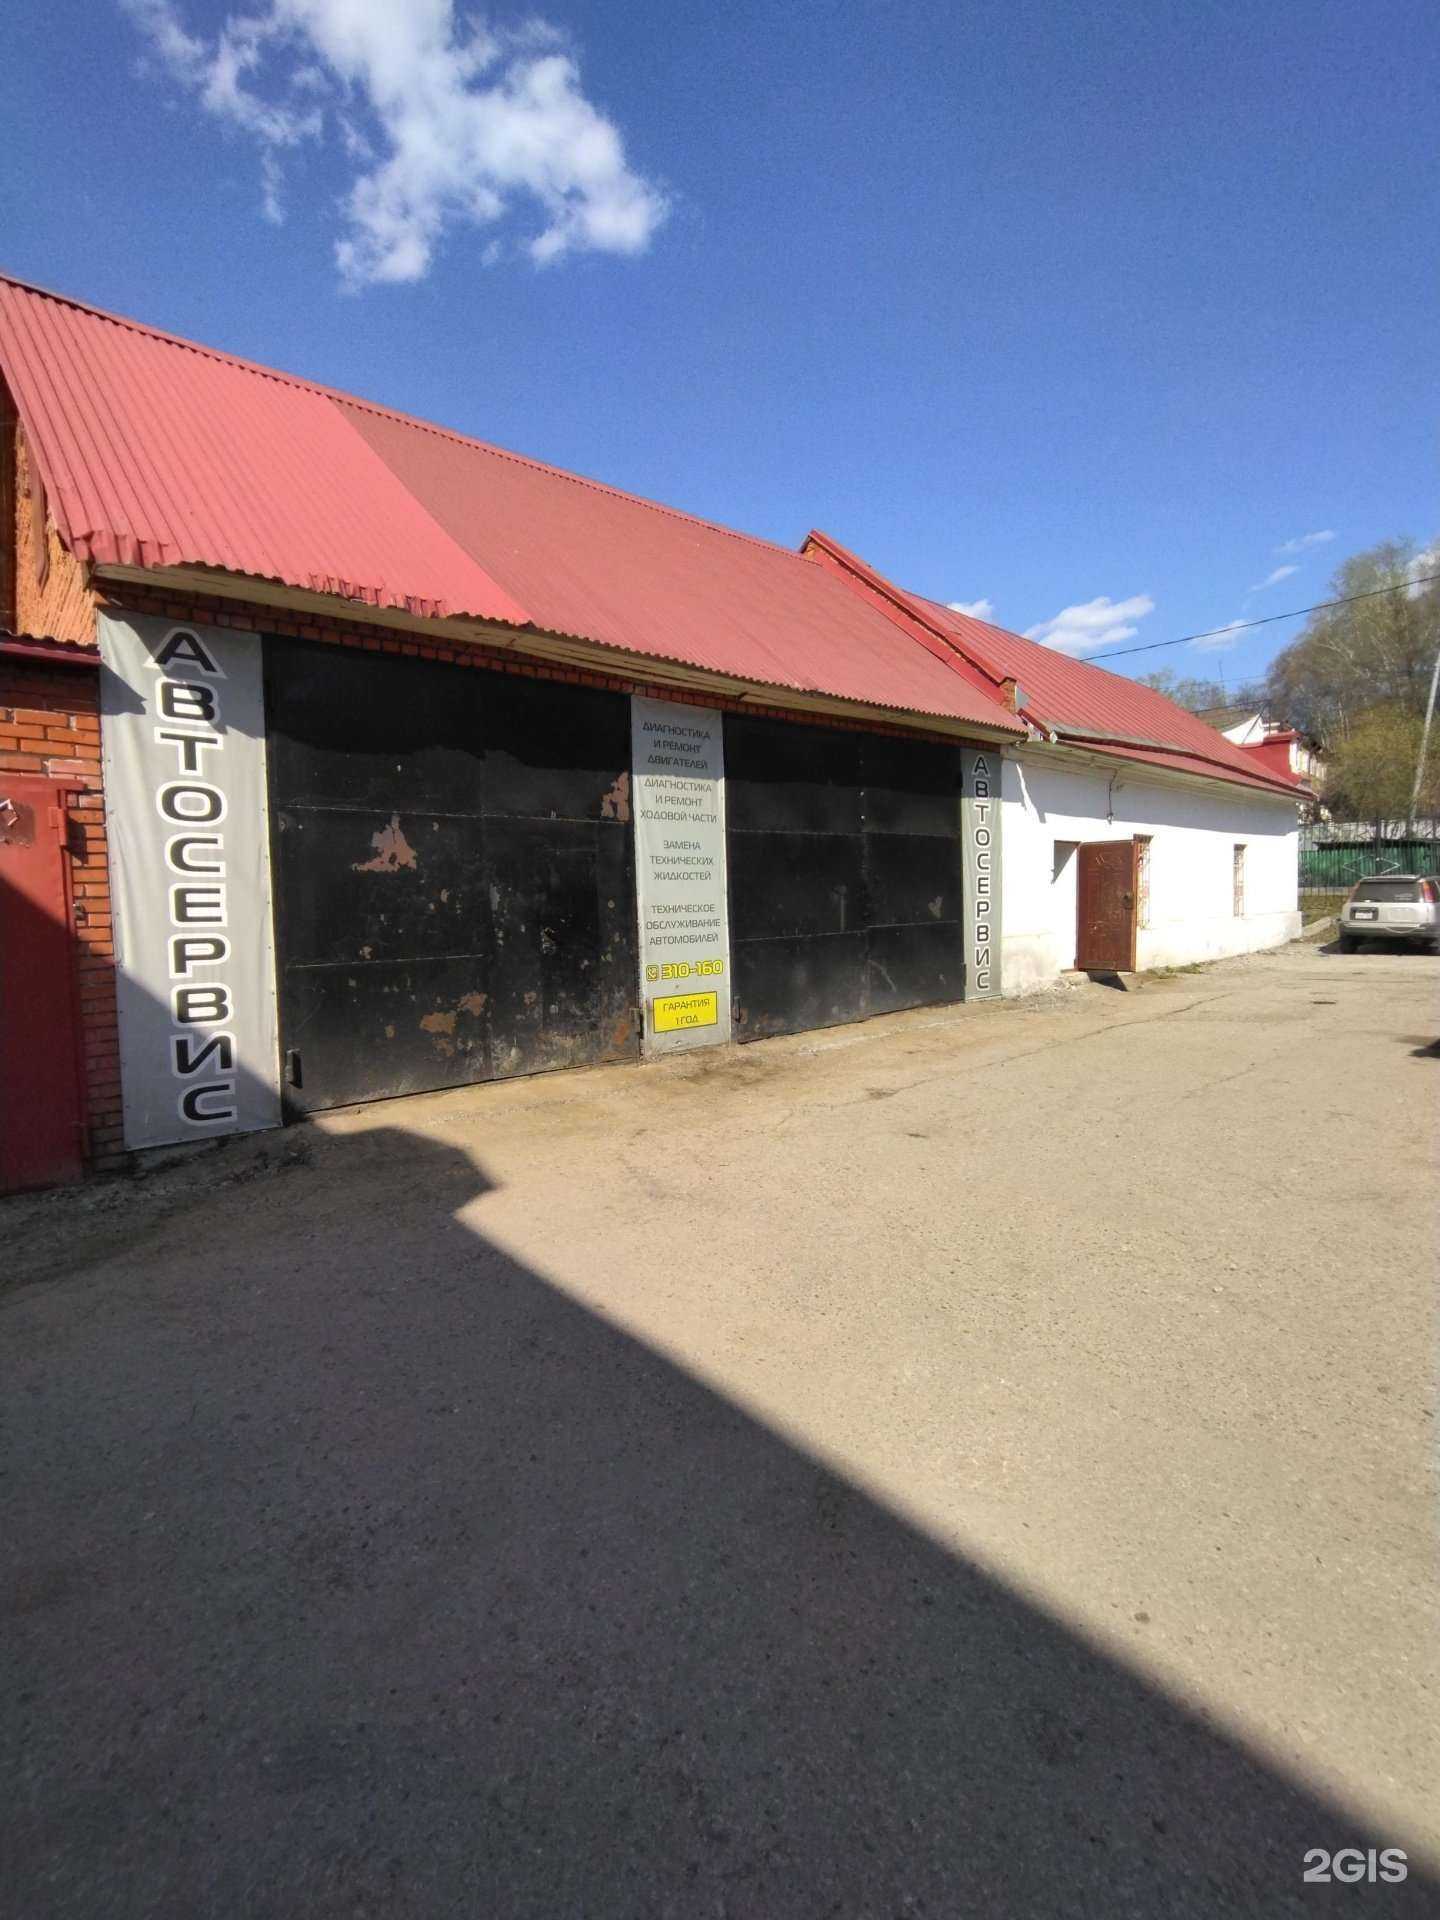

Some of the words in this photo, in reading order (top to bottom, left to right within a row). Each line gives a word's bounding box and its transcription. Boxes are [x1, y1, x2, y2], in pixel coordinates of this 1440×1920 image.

[642, 722, 711, 740] ДИАГНОСТИКА
[653, 741, 661, 749] И
[663, 742, 702, 753] РЕМОНТ
[647, 754, 708, 769] ДВИГАТЕЛЕЙ
[644, 778, 712, 792] ДИАГНОСТИКА
[655, 795, 663, 804] И
[664, 796, 703, 807] РЕМОНТ
[640, 809, 687, 821] ХОДОВОЙ
[689, 812, 717, 823] ЧАСТИ
[663, 840, 701, 850] ЗАМЕНА
[651, 855, 713, 865] ТЕХНИЧЕСКИХ
[150, 631, 234, 1121] АВТОСЕРВИС
[653, 870, 711, 881] ЖИДКОСТЕЙ
[974, 757, 990, 989] АВТОСЕРВИС
[652, 904, 716, 914] ТЕХНИЧЕСКОЕ
[647, 918, 721, 930] ОБСЛУЖИВАНИЕ
[649, 933, 719, 946] АВТОМОБИЛЕЙ
[661, 960, 724, 980] 310-160
[663, 998, 710, 1013] ГАРАНТИЯ
[680, 1014, 699, 1025] ГОД
